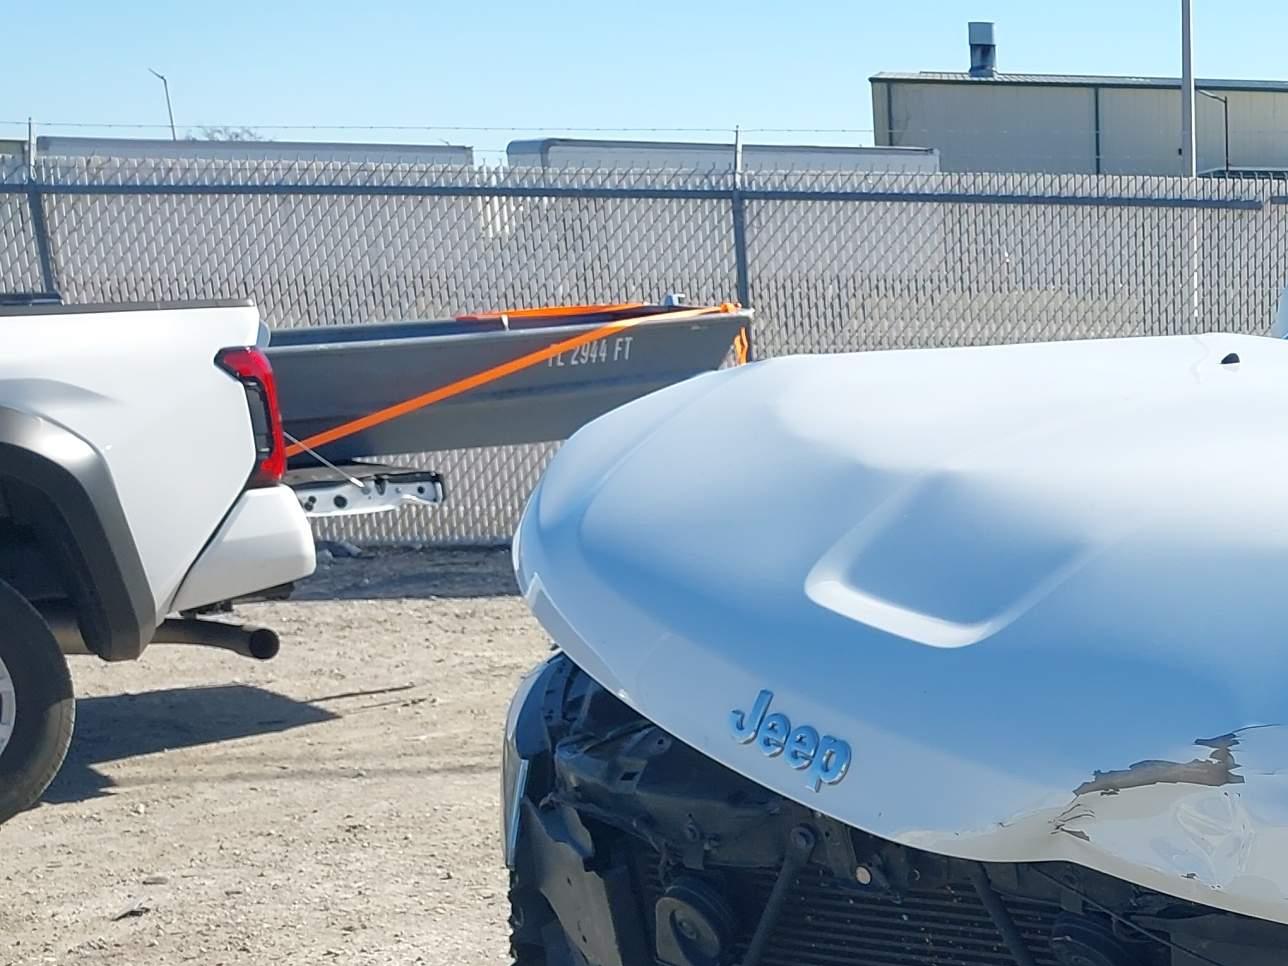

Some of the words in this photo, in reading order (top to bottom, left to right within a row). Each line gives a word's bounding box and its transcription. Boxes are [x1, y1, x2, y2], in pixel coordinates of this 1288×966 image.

[570, 340, 608, 366] 2944
[613, 337, 633, 361] FT
[729, 689, 852, 793] Jeep
